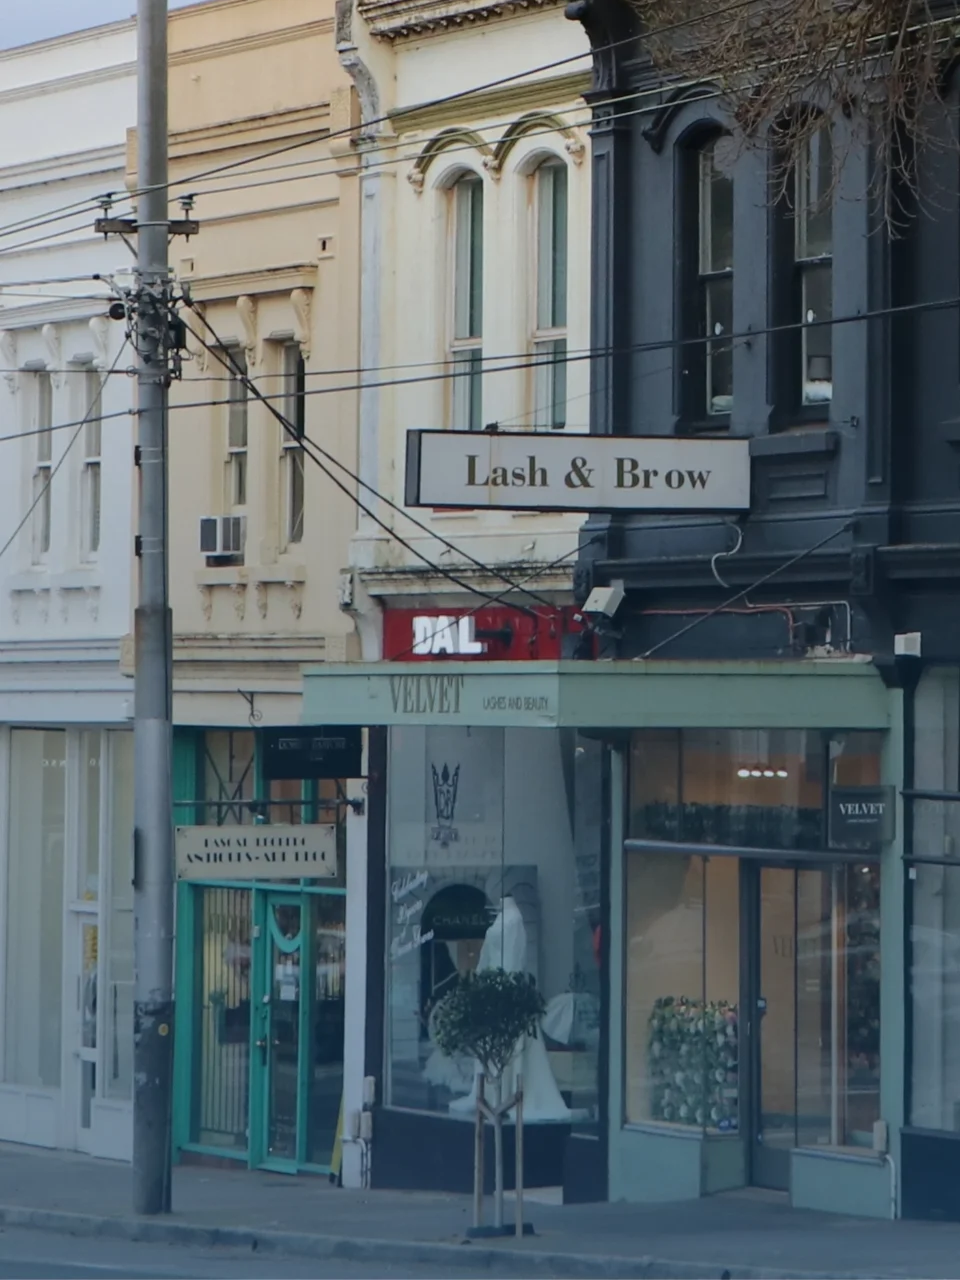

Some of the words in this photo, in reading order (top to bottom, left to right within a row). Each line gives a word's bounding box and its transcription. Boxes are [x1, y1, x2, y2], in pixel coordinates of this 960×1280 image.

[465, 454, 549, 487] Lash
[564, 456, 595, 489] &
[614, 457, 712, 490] Brow
[390, 674, 464, 714] VELVET
[483, 696, 507, 710] LASHES
[508, 696, 522, 710] AND
[524, 696, 549, 711] BEAUTY
[839, 803, 886, 815] VELVET
